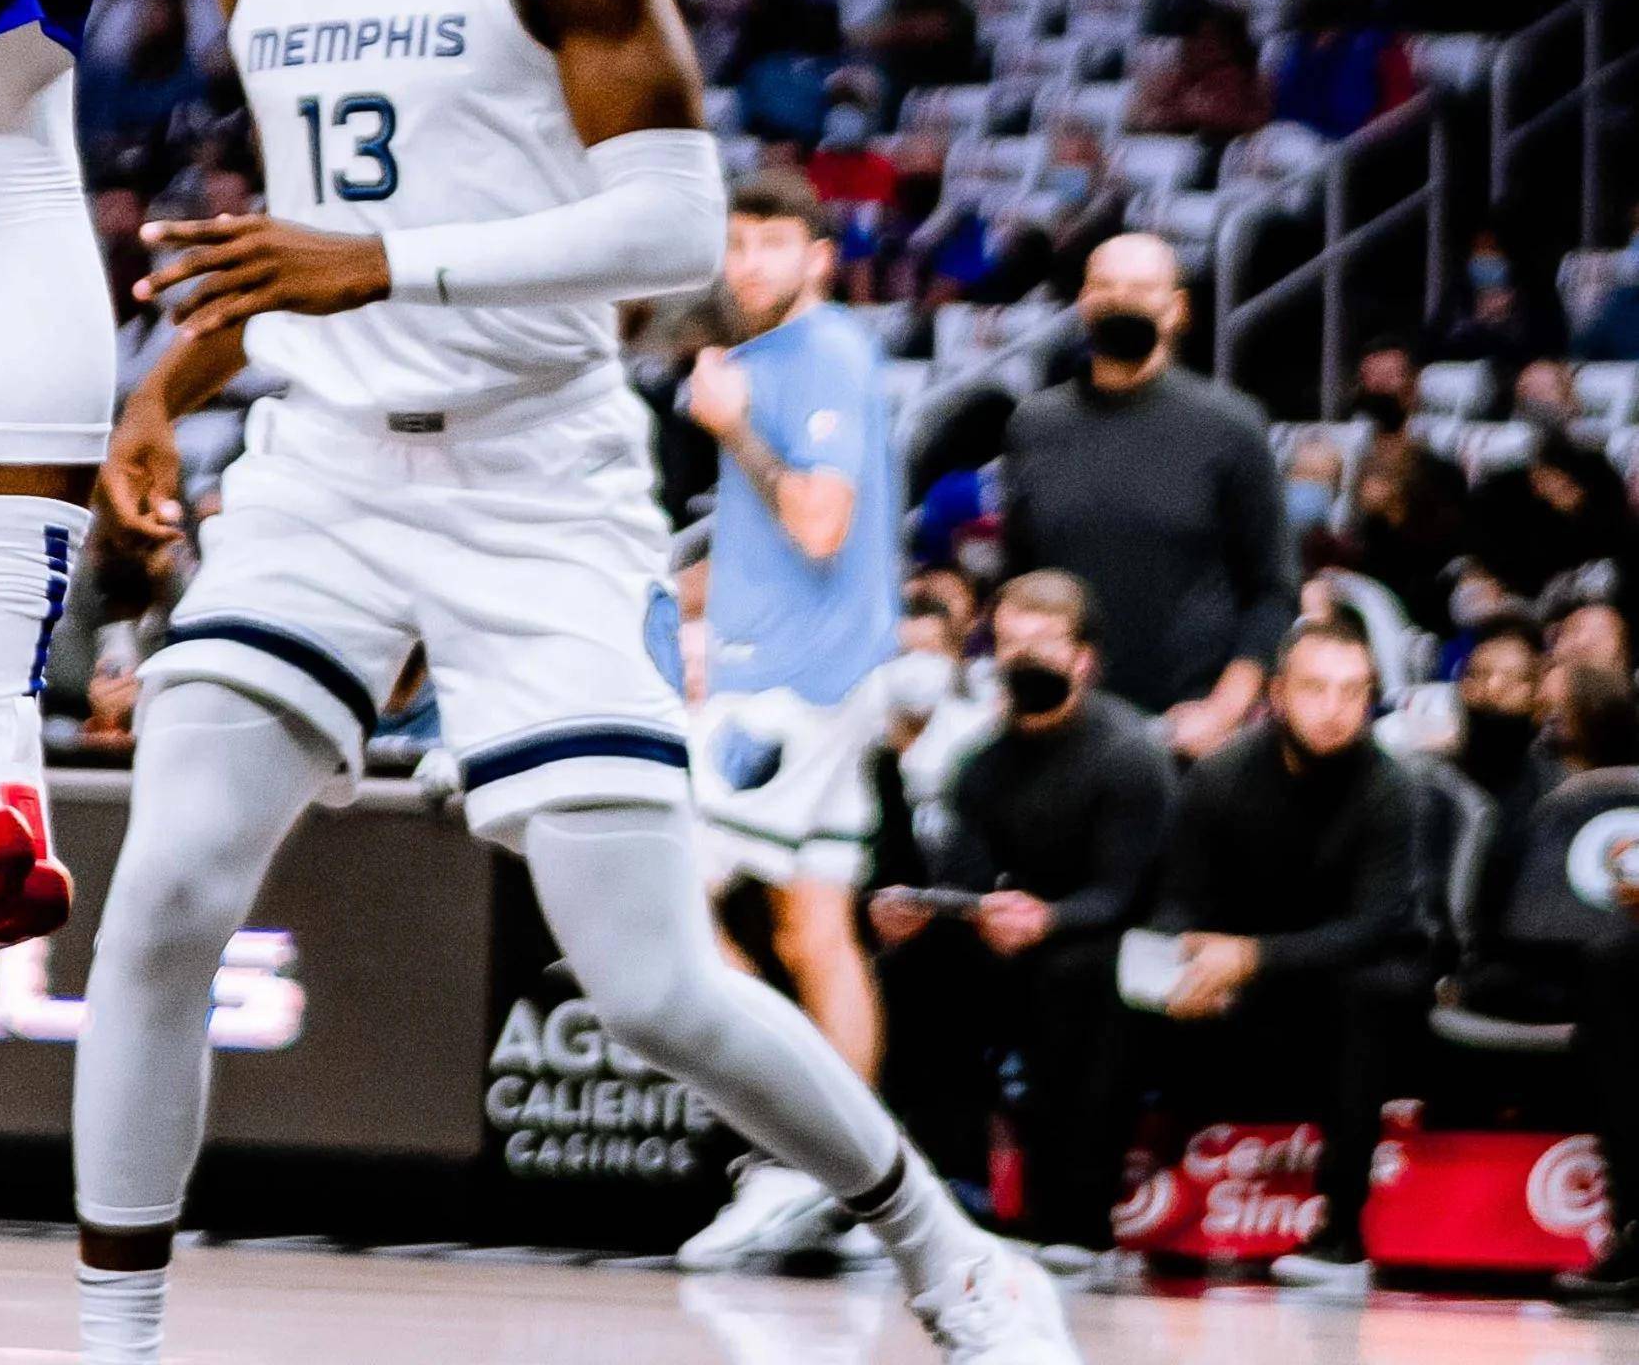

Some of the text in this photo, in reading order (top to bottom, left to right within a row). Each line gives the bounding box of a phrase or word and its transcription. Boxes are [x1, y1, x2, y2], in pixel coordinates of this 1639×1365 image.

[247, 14, 467, 72] MEMPHIS
[298, 92, 398, 205] 13
[486, 1075, 714, 1130] CALIENTE
[506, 1130, 696, 1173] CASINOS
